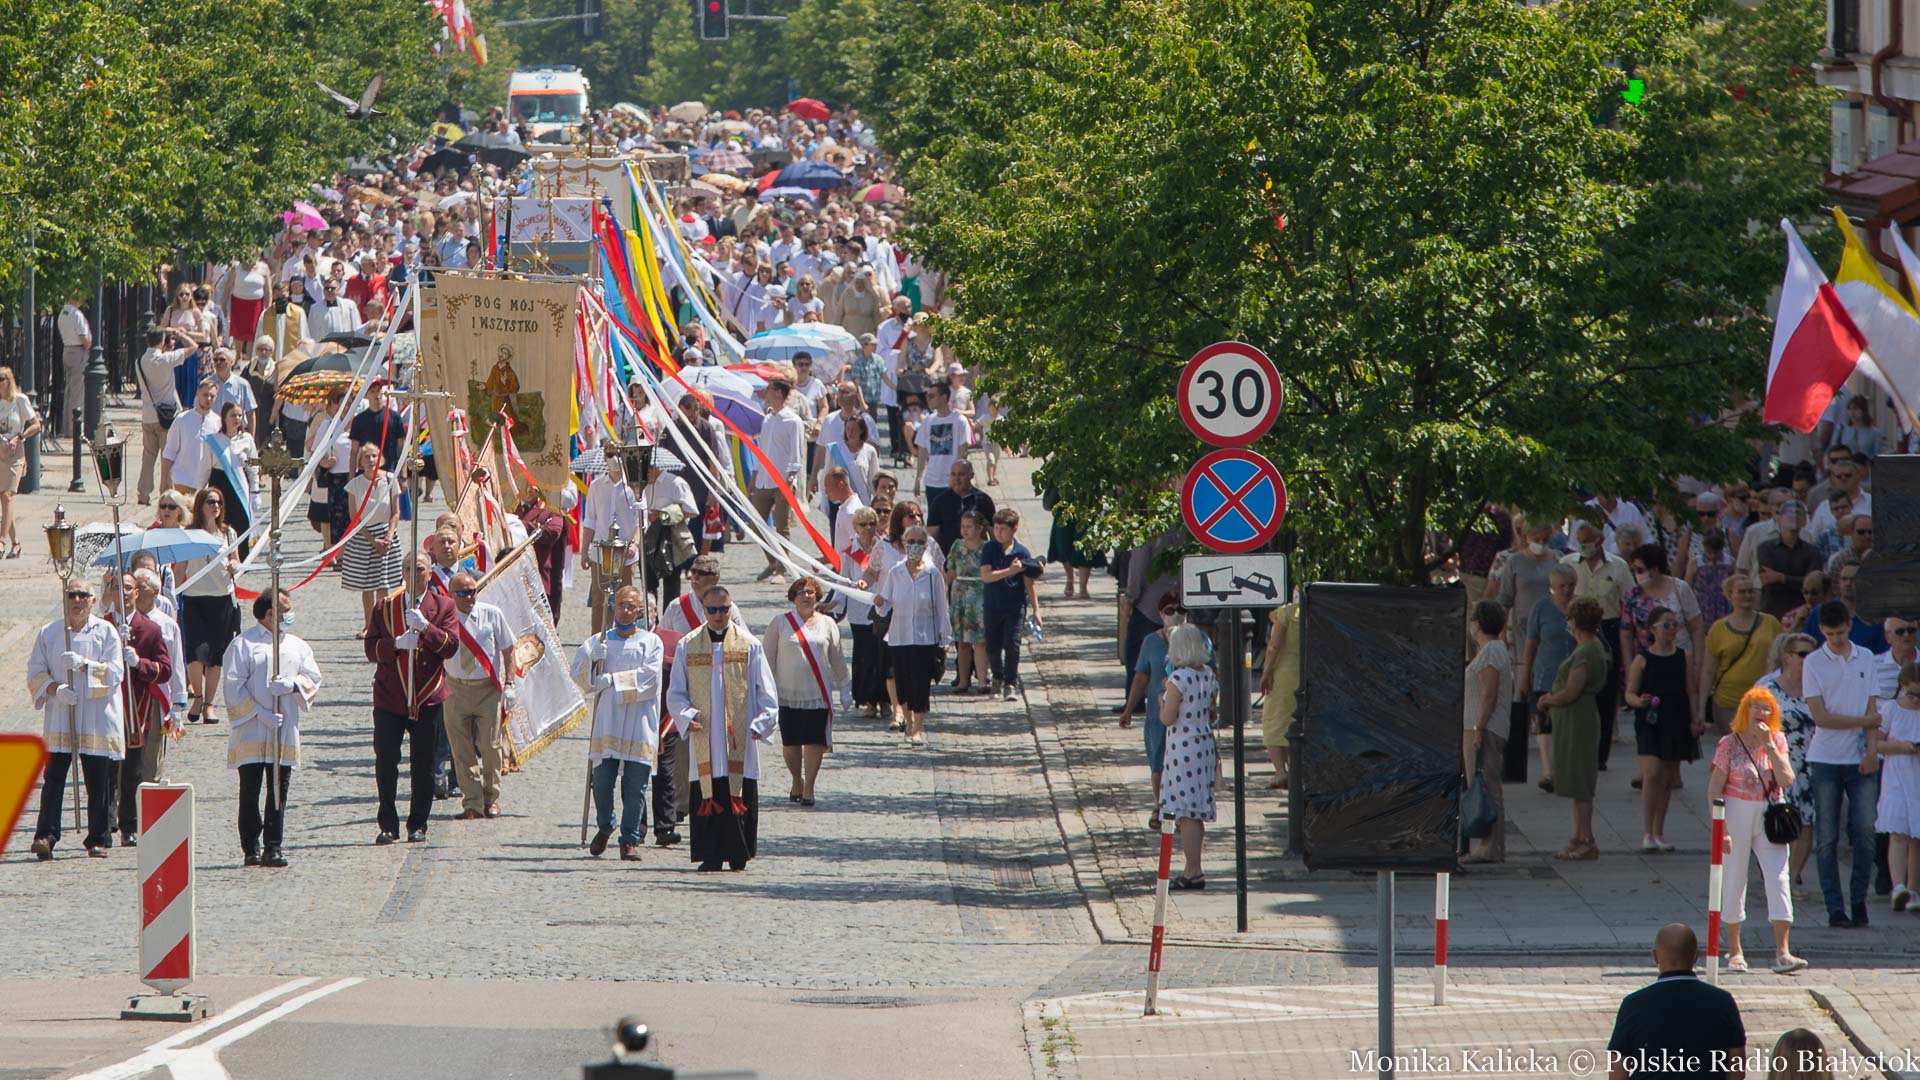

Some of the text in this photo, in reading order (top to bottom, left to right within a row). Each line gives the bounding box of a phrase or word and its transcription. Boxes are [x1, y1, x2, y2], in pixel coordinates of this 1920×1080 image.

[472, 316, 538, 333] I WSZYSTKO
[1196, 368, 1264, 419] 30
